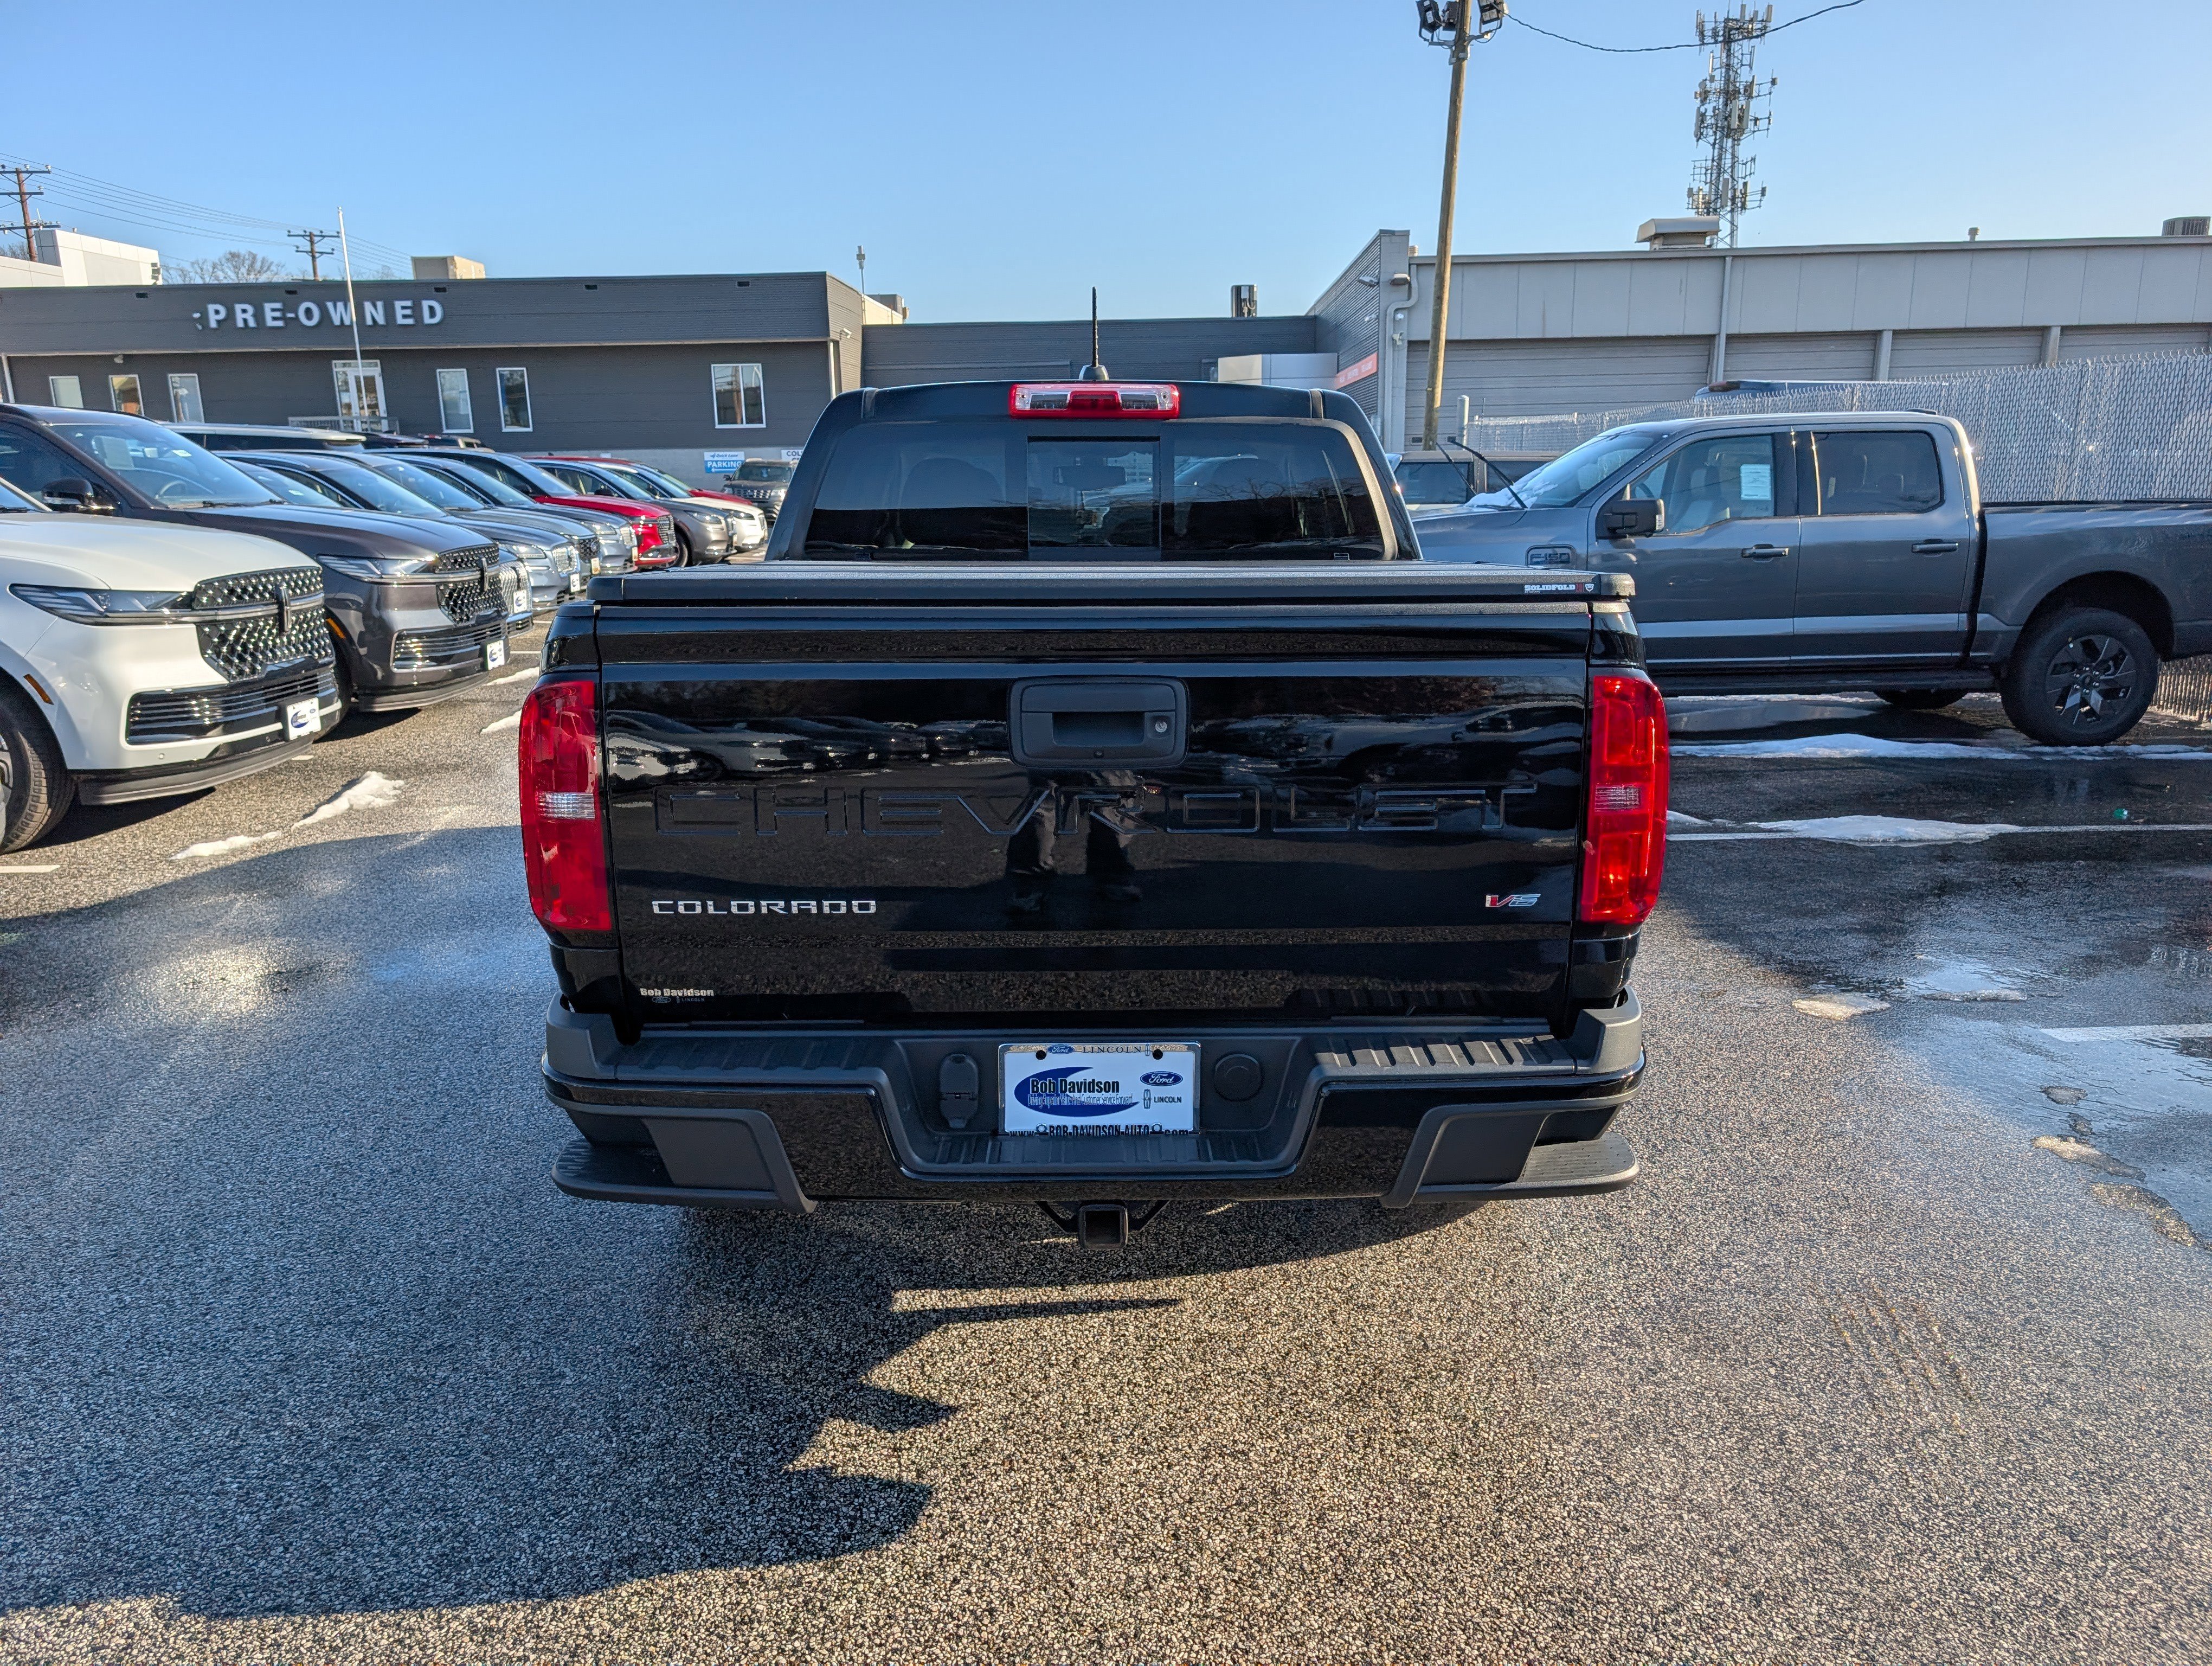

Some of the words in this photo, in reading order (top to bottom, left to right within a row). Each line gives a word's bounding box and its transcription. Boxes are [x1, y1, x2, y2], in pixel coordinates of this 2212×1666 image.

[207, 299, 444, 328] PRE-OWNED
[654, 783, 1538, 835] CHEVROLET
[652, 900, 876, 914] COLORADO
[640, 988, 661, 996] Bob
[663, 988, 714, 996] Davidson
[1031, 1078, 1056, 1094] Bob
[1059, 1078, 1120, 1094] Davidson
